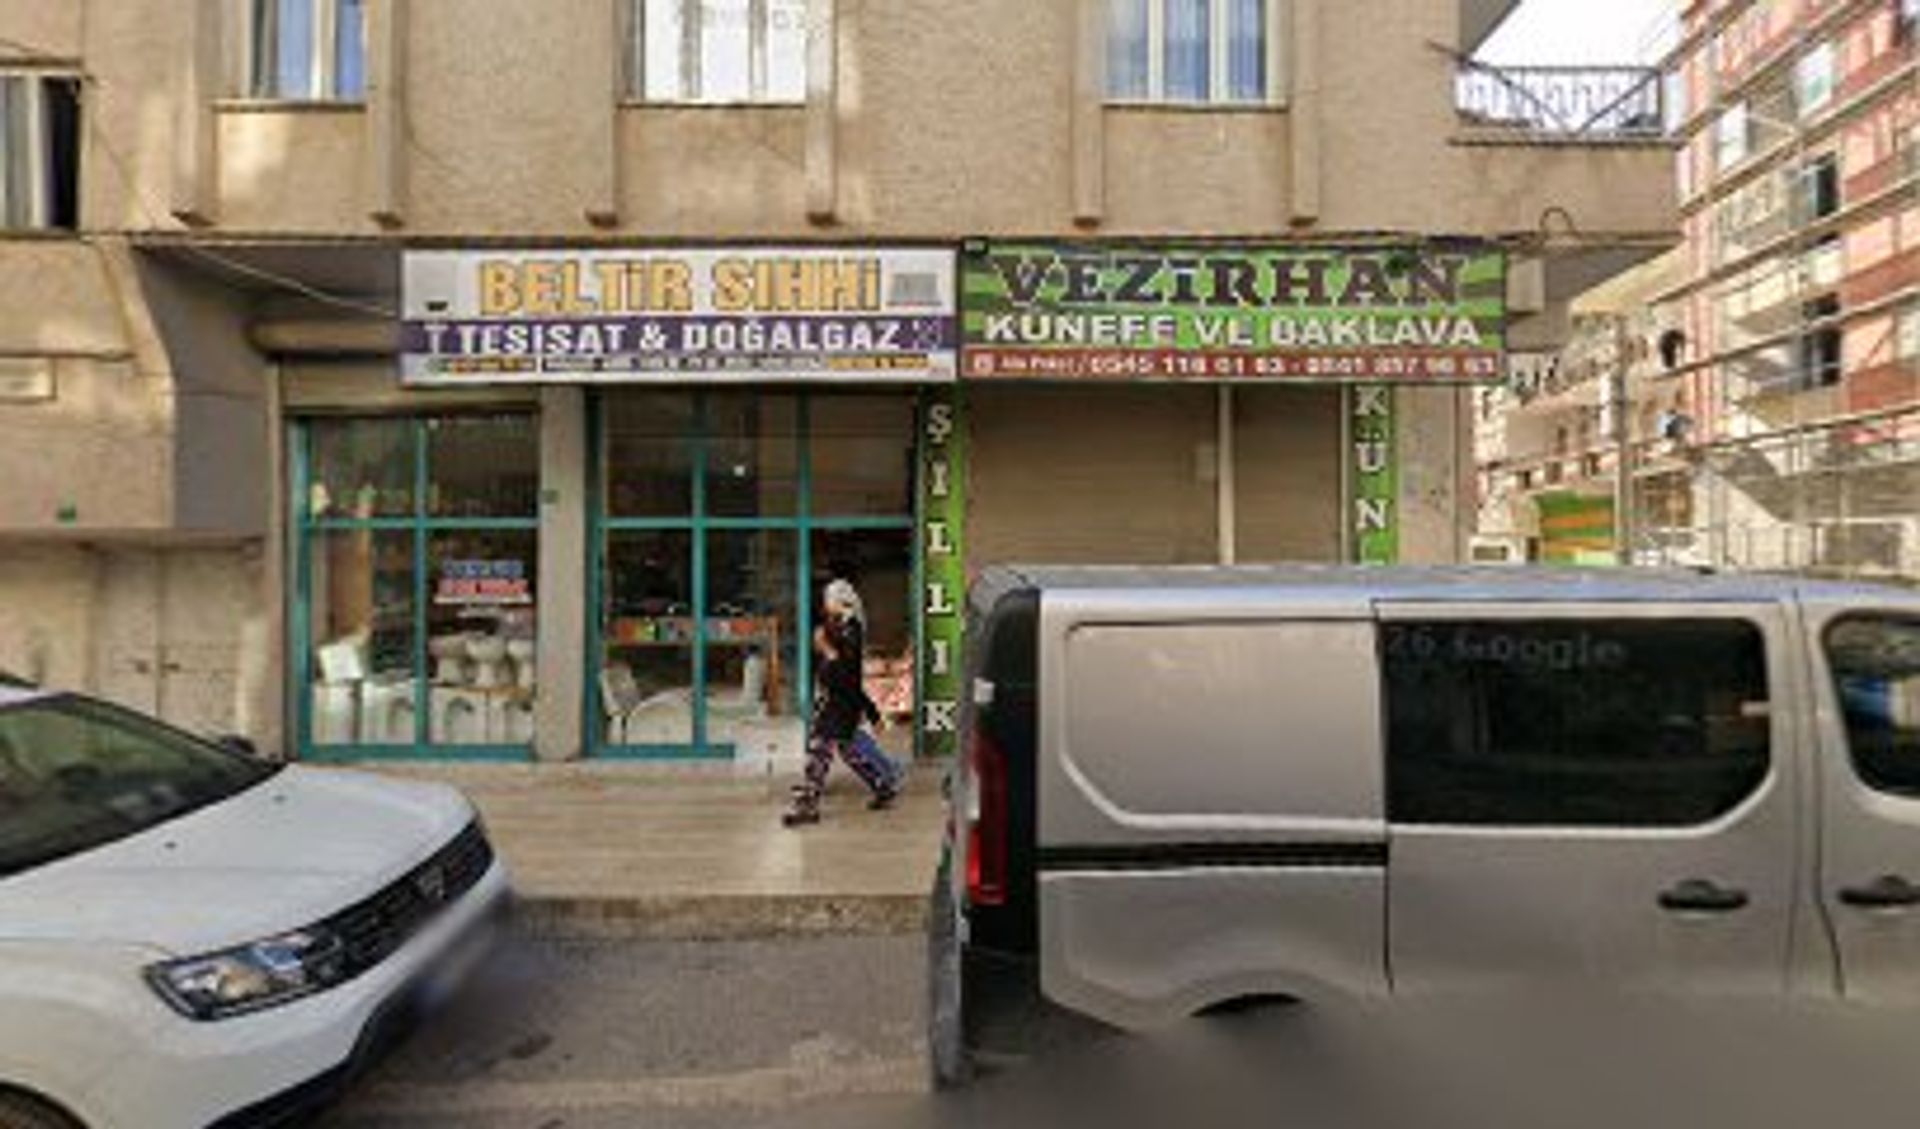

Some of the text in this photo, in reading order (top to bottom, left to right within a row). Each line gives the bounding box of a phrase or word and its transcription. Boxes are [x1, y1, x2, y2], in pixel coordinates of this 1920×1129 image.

[639, 321, 668, 351] &
[681, 320, 901, 352] DOĞALGAZ
[1270, 315, 1482, 346] BAKLAVA
